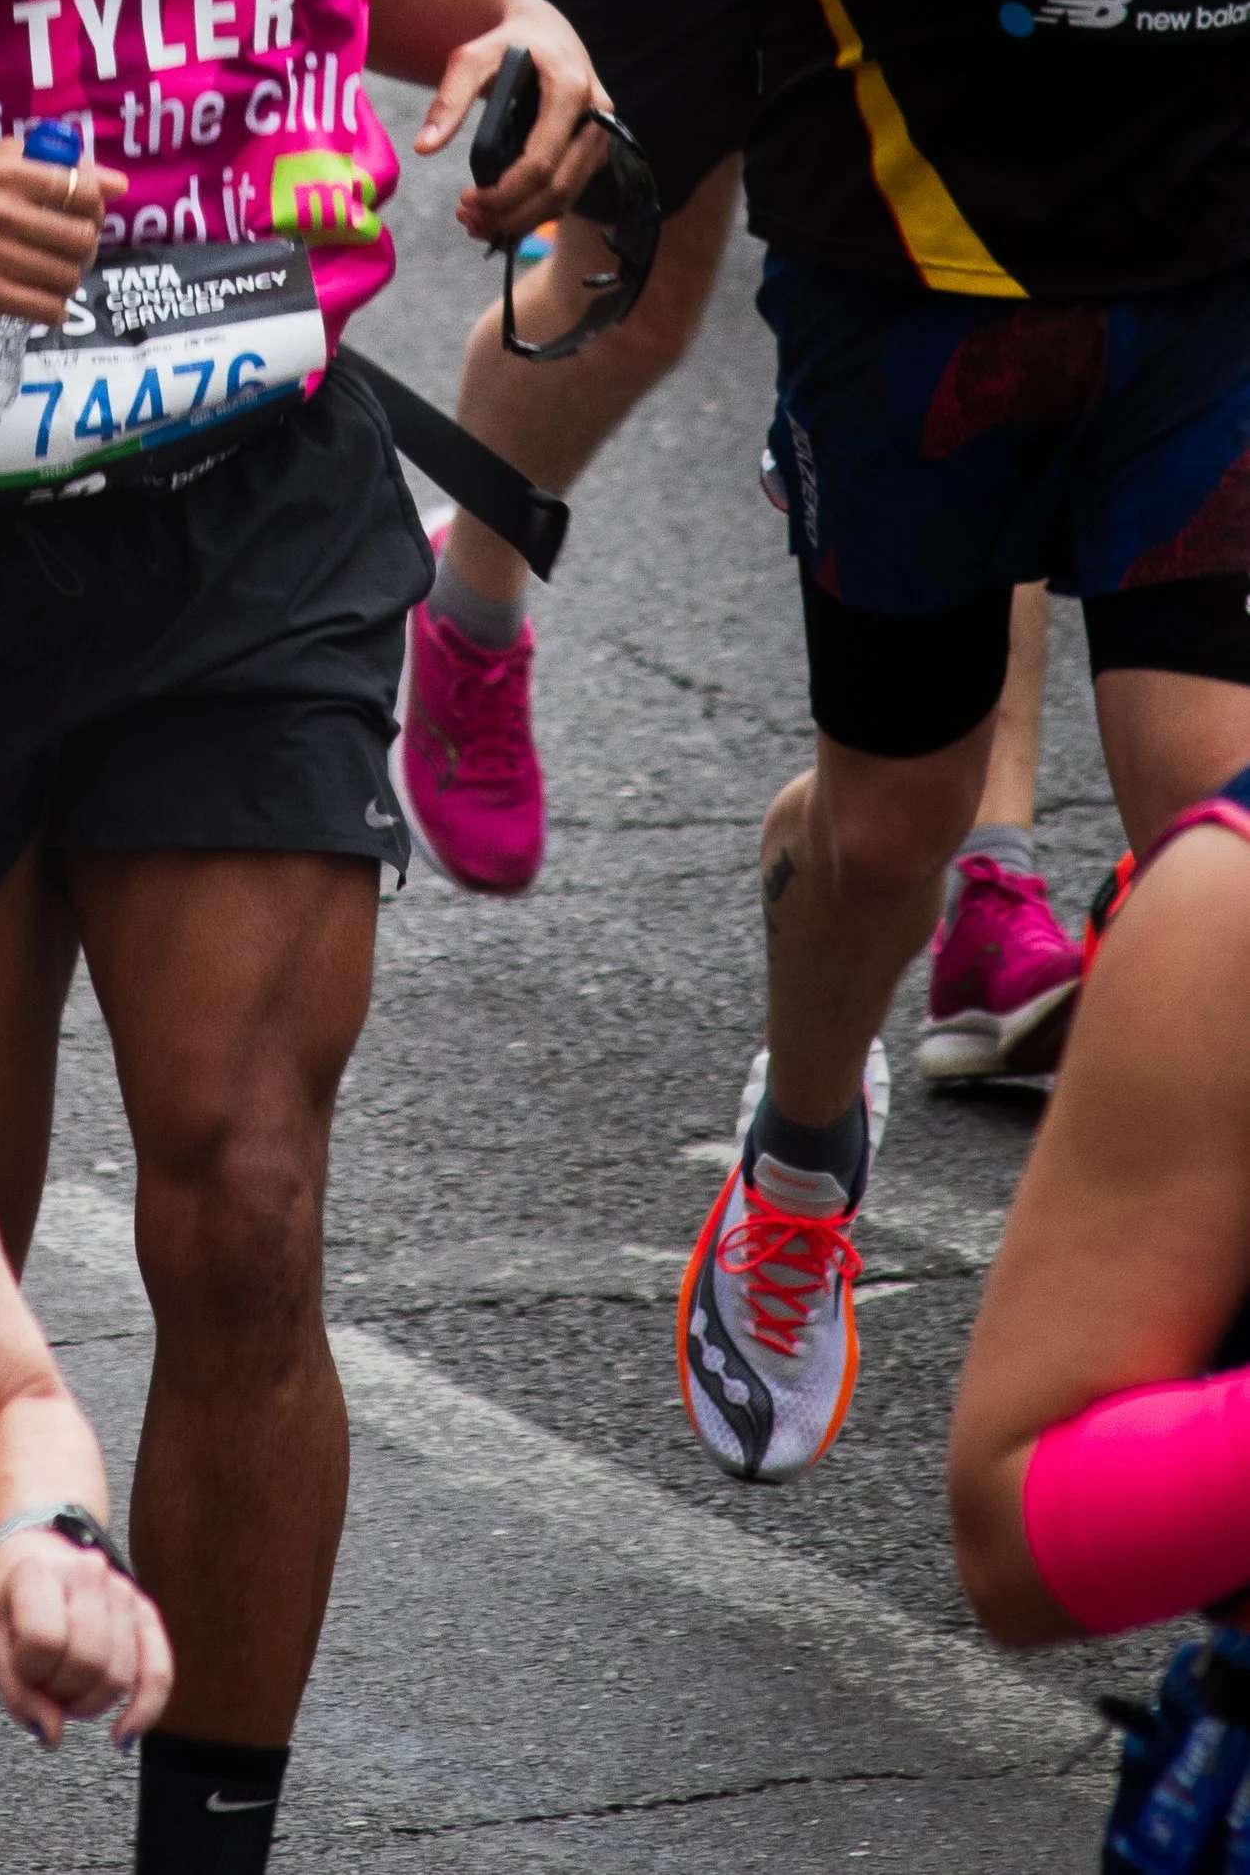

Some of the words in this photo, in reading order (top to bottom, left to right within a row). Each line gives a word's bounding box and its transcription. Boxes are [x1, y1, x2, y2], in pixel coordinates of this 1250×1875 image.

[1136, 10, 1192, 31] new
[121, 79, 225, 157] the
[102, 262, 182, 297] TATA
[106, 269, 288, 312] CONSULTANCY
[111, 295, 225, 338] SERVICES
